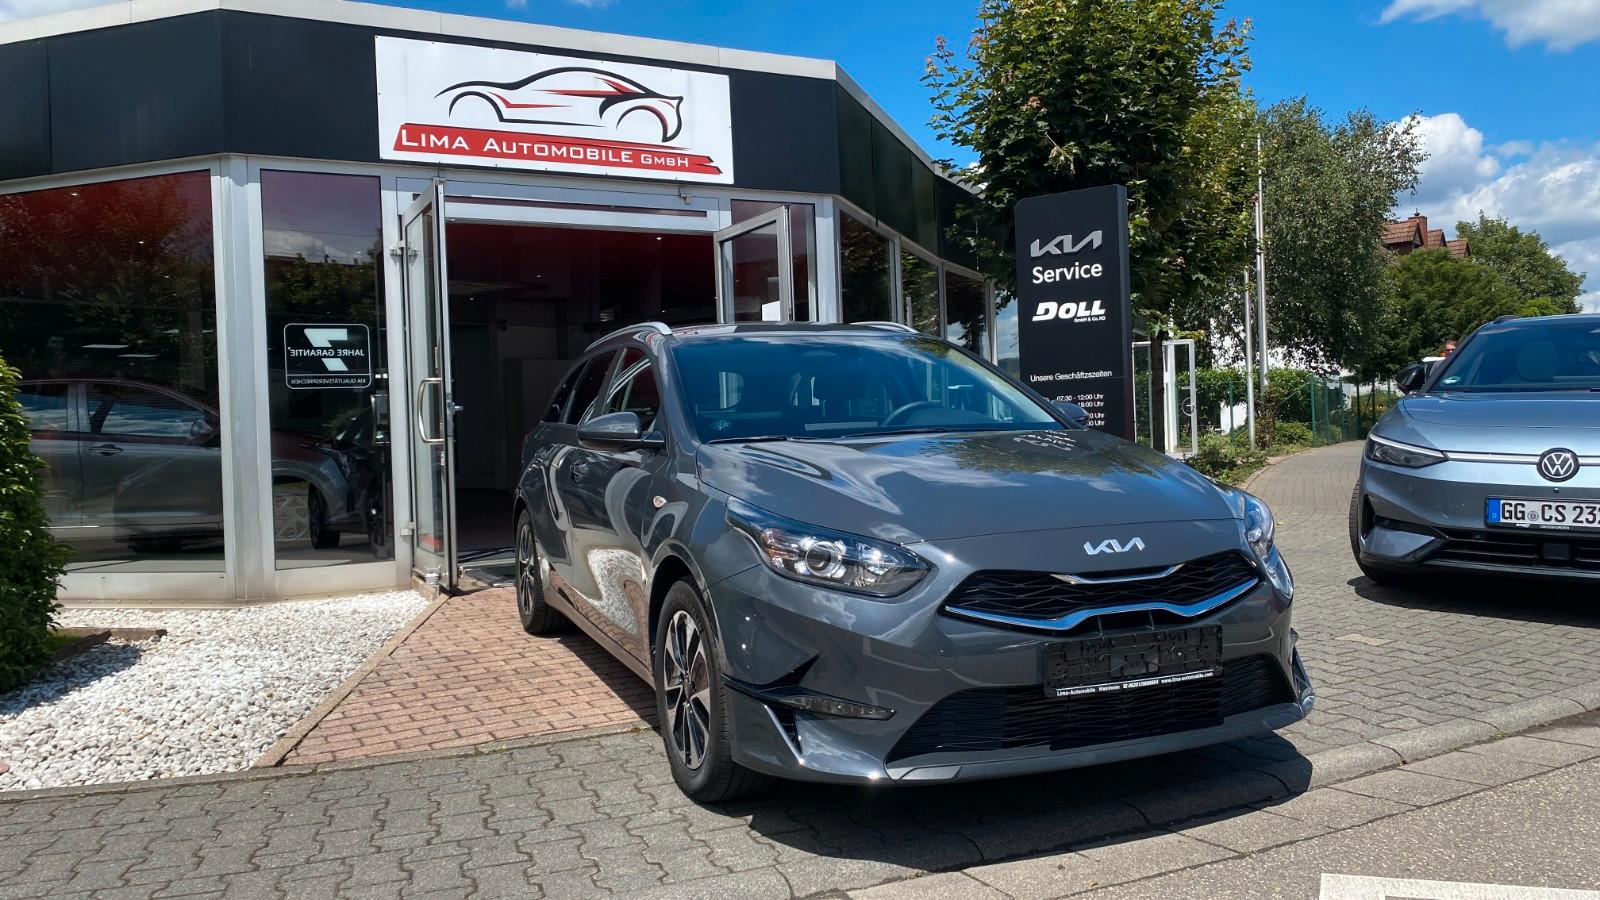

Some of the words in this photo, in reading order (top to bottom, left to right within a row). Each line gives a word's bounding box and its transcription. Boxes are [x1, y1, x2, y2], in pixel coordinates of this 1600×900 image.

[400, 128, 470, 150] LIMA
[482, 137, 634, 163] AUTOMOBILE
[1030, 230, 1103, 257] KIA
[1032, 261, 1103, 284] Service
[1032, 300, 1106, 321] DOLL
[1030, 373, 1054, 382] Unsere
[1502, 502, 1526, 521] GG
[1541, 504, 1567, 522] CS
[1083, 537, 1146, 555] KIA
